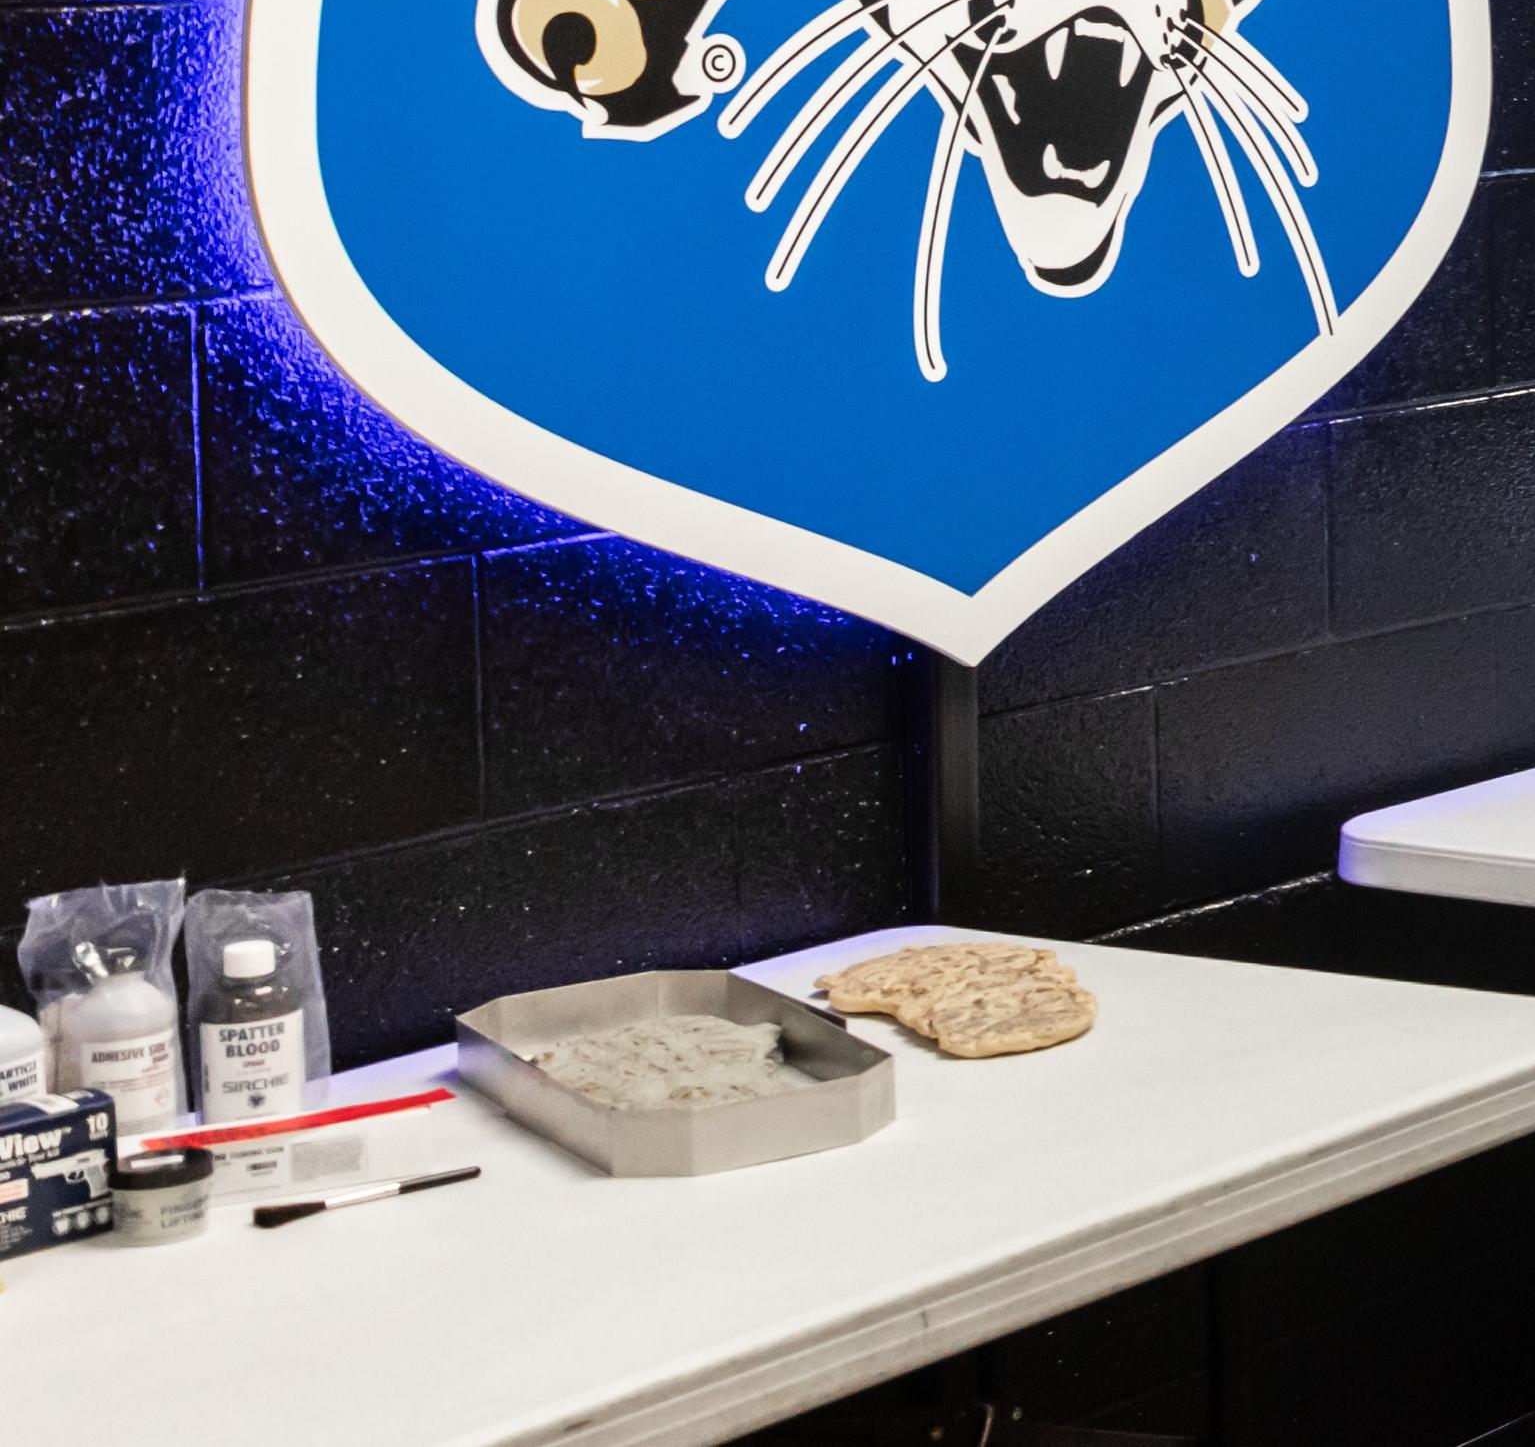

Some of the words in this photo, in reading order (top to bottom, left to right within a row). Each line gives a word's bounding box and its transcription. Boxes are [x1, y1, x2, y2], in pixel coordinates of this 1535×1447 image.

[219, 1022, 285, 1043] SPATTER
[226, 1039, 280, 1058] BLOOD
[86, 1112, 109, 1133] 10
